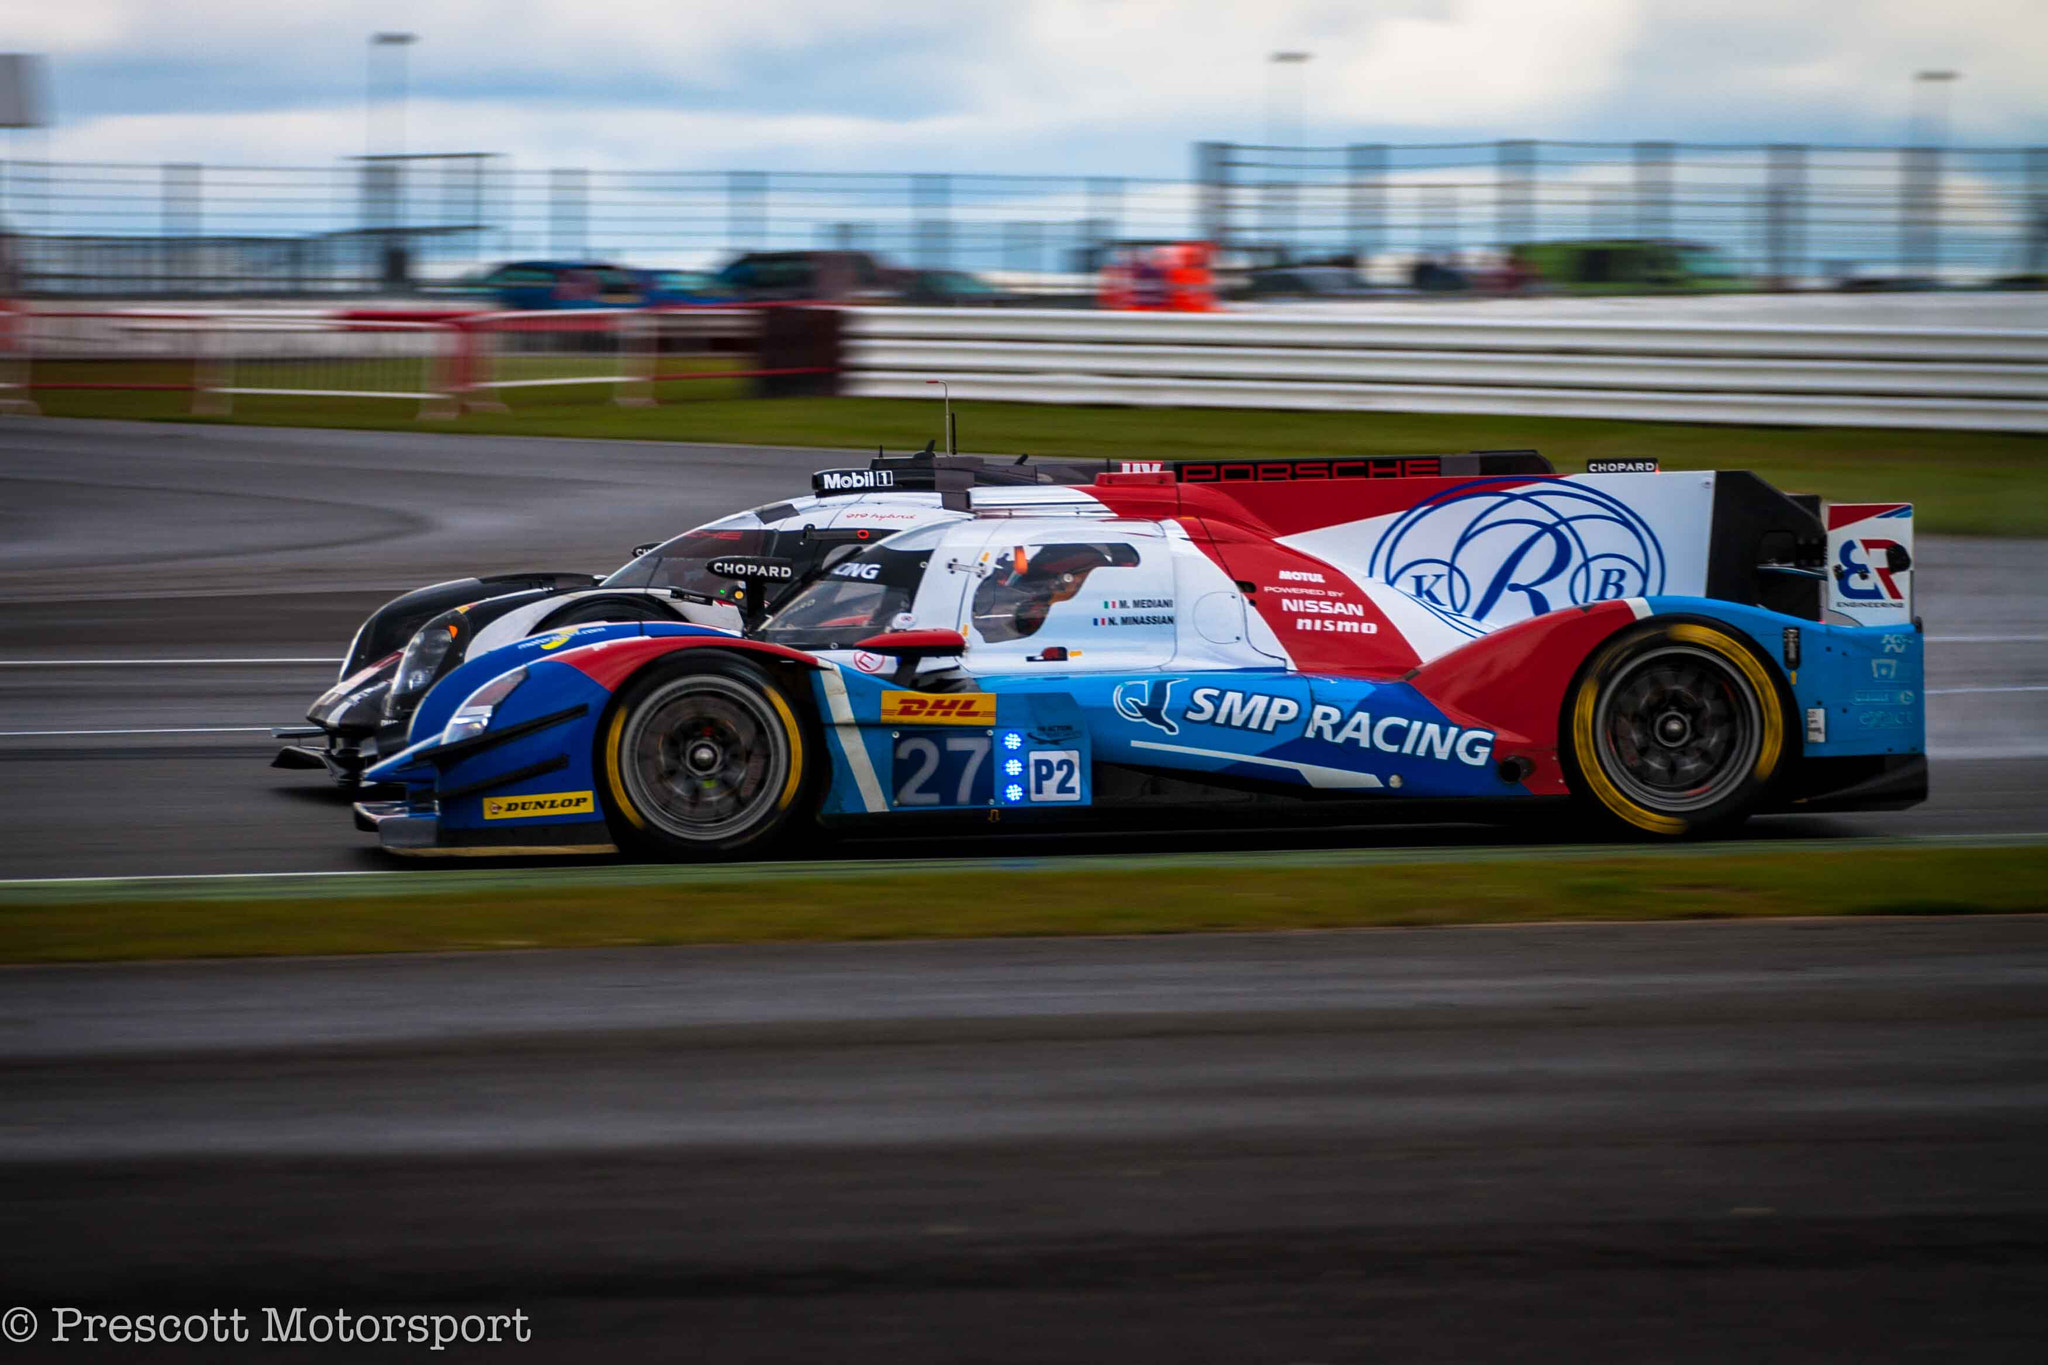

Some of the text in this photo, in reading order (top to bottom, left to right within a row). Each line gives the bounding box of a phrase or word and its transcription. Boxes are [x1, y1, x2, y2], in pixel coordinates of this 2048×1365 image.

[1182, 459, 1439, 481] PORSCHE
[1588, 462, 1655, 472] CHOPARD
[823, 470, 894, 489] Mobil 1
[713, 562, 792, 578] CHOPARD
[1278, 570, 1326, 583] MOTUL
[1263, 586, 1326, 596] POWERED
[1596, 567, 1626, 600] B
[1118, 599, 1174, 609] M. MEDIANI
[1281, 598, 1364, 616] NISSAN
[1108, 615, 1174, 626] N. MINASSIAN
[1296, 618, 1378, 634] nismo
[897, 698, 982, 717] DHL
[1186, 688, 1496, 767] SMP RACING
[895, 736, 991, 806] 27
[1033, 758, 1076, 795] P2
[505, 797, 589, 812] DUNLOP
